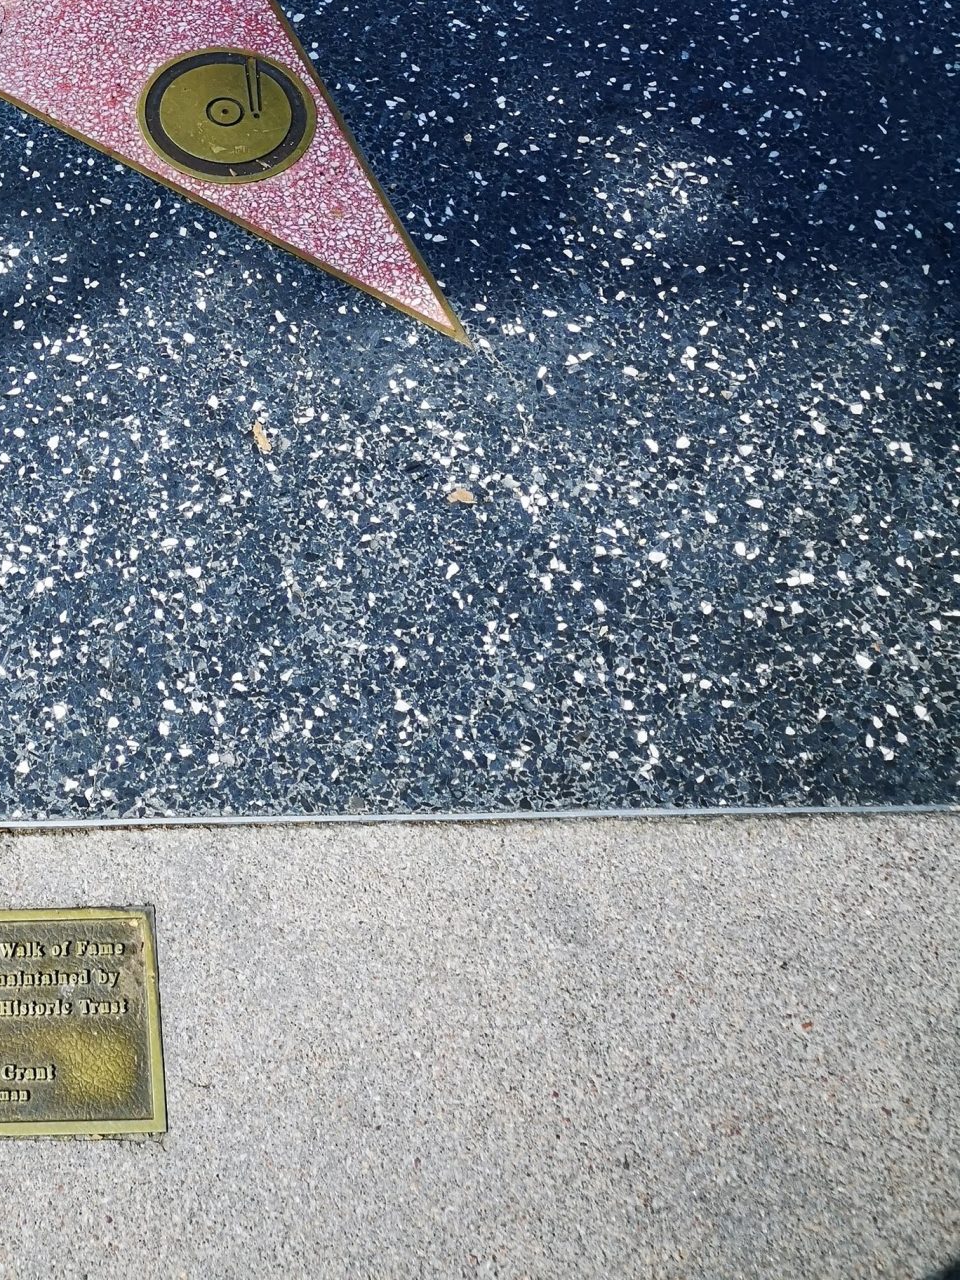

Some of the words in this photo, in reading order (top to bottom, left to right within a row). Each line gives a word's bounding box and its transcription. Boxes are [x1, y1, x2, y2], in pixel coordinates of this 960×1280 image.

[51, 941, 70, 957] of
[76, 941, 125, 956] Fame
[98, 969, 120, 987] by
[79, 998, 128, 1015] Trust
[0, 1064, 56, 1081] Grant
